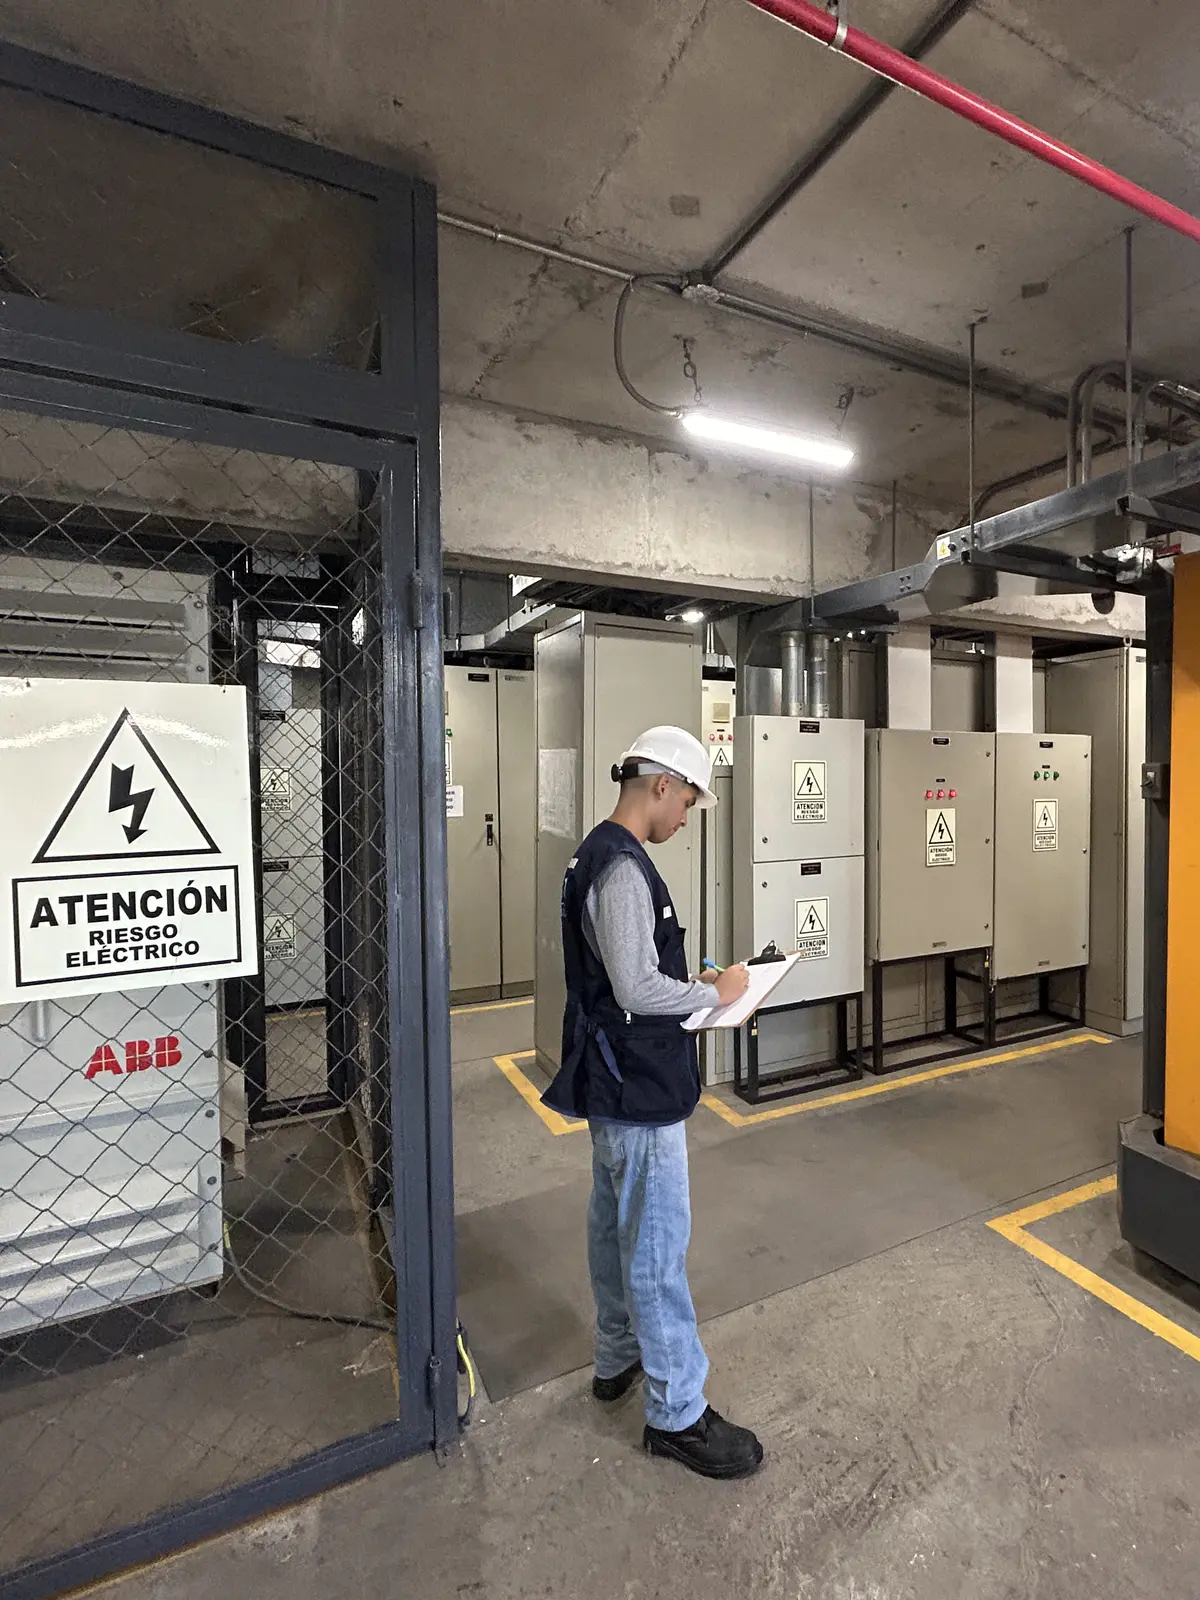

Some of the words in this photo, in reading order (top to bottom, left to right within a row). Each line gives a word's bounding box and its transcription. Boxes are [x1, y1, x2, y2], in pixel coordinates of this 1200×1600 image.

[30, 880, 228, 928] ATENCIÓN
[89, 923, 178, 946] RIESGO
[66, 940, 200, 968] ELÉCTRICO
[84, 1036, 183, 1080] ABB
